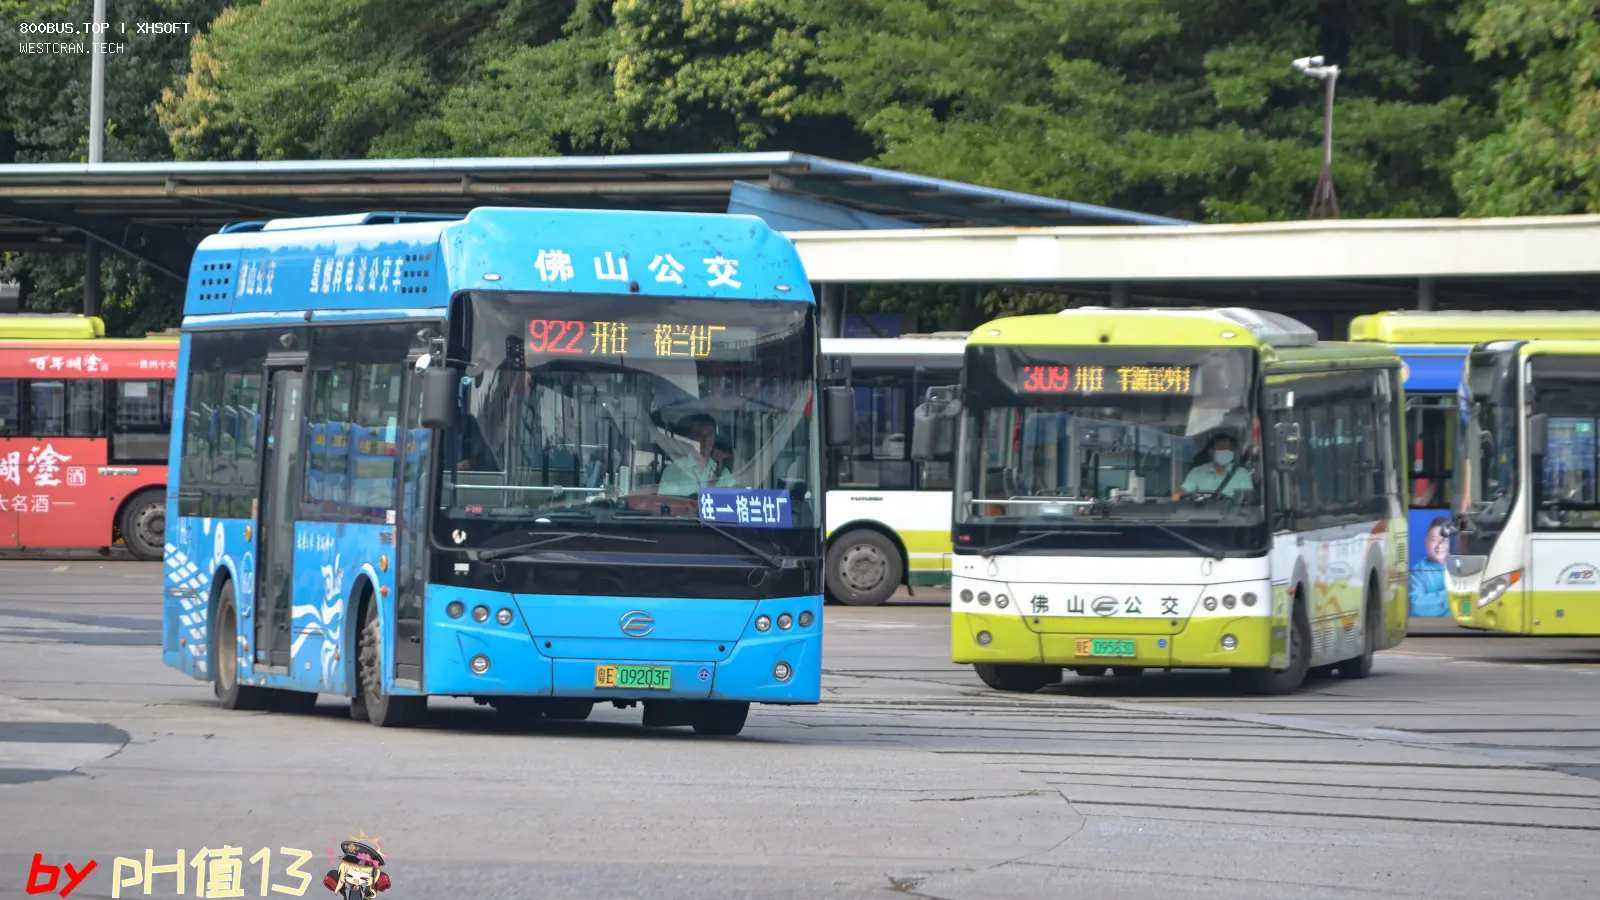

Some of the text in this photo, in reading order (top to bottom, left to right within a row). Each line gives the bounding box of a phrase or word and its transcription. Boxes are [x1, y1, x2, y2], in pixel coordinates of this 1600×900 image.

[535, 248, 743, 290] 佛山公交
[529, 319, 726, 357] 922 开往 格兰仕厂
[1024, 365, 1069, 392] 309
[701, 493, 788, 523] 往 格兰仕厂
[1030, 594, 1180, 616] 佛山公交
